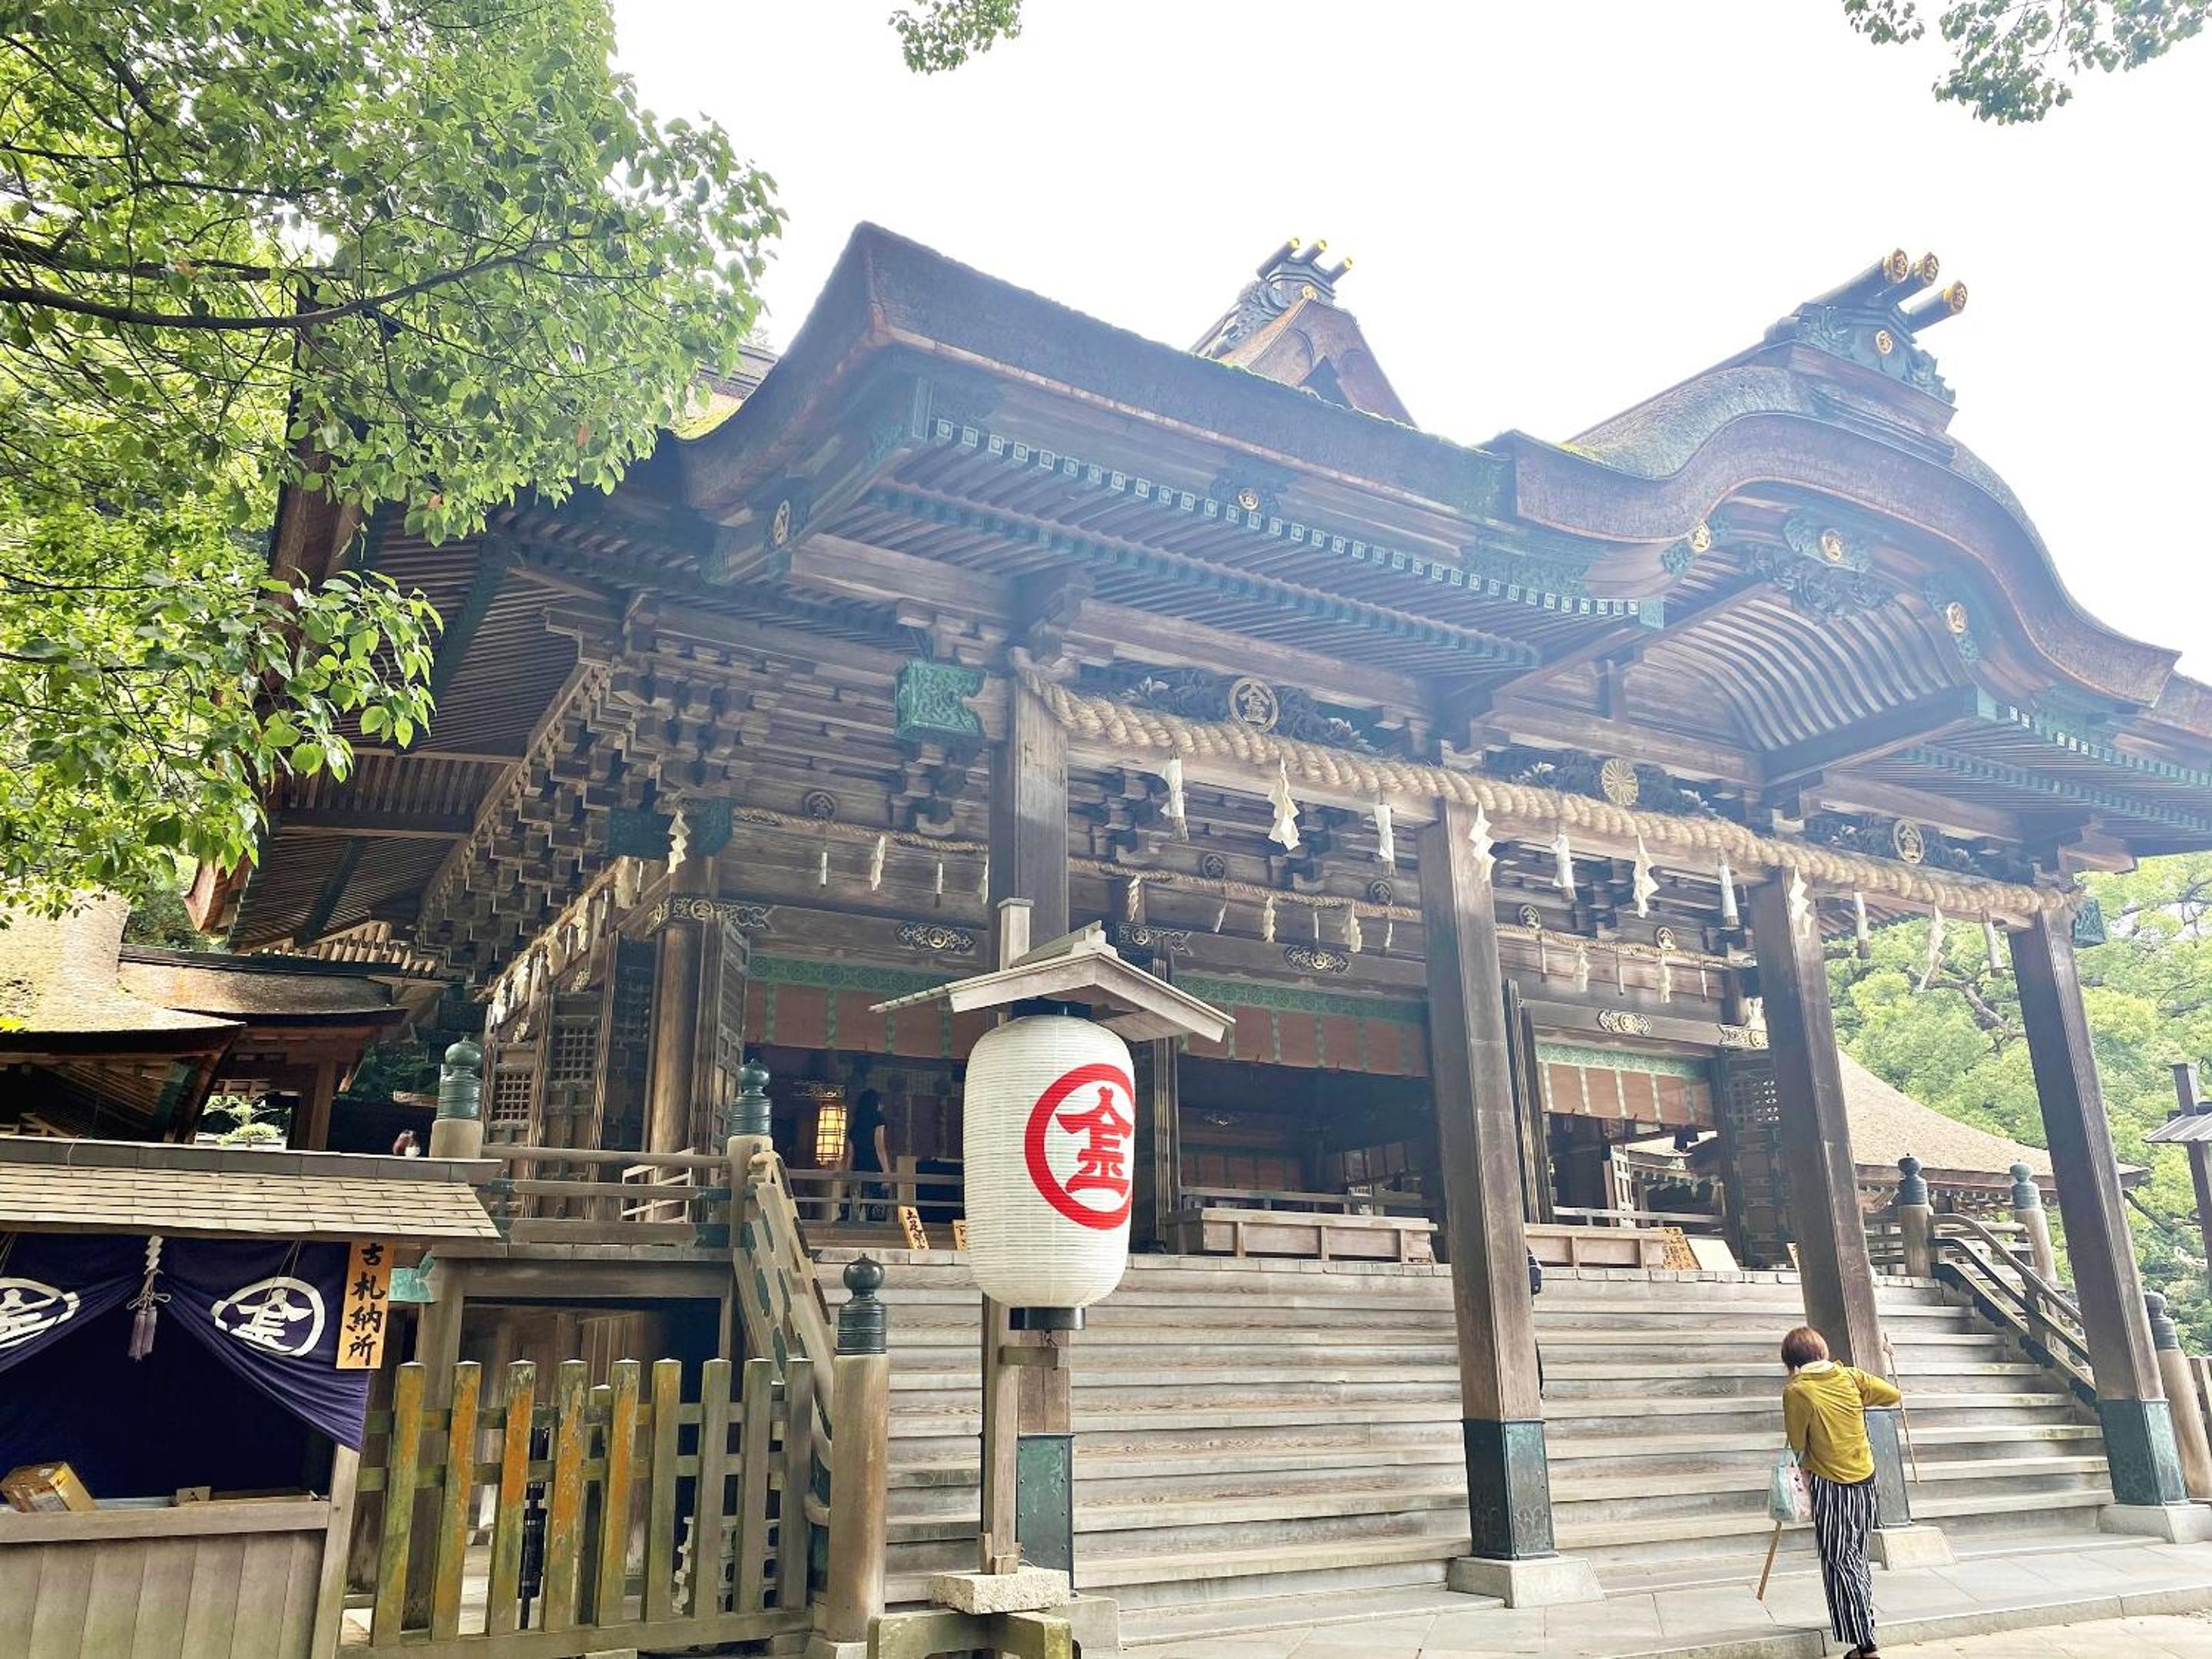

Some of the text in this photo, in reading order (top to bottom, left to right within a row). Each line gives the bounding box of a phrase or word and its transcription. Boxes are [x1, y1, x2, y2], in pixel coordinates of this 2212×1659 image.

[1055, 1086, 1133, 1198] 金
[230, 1288, 313, 1353] 金
[346, 1242, 386, 1366] 古札納所
